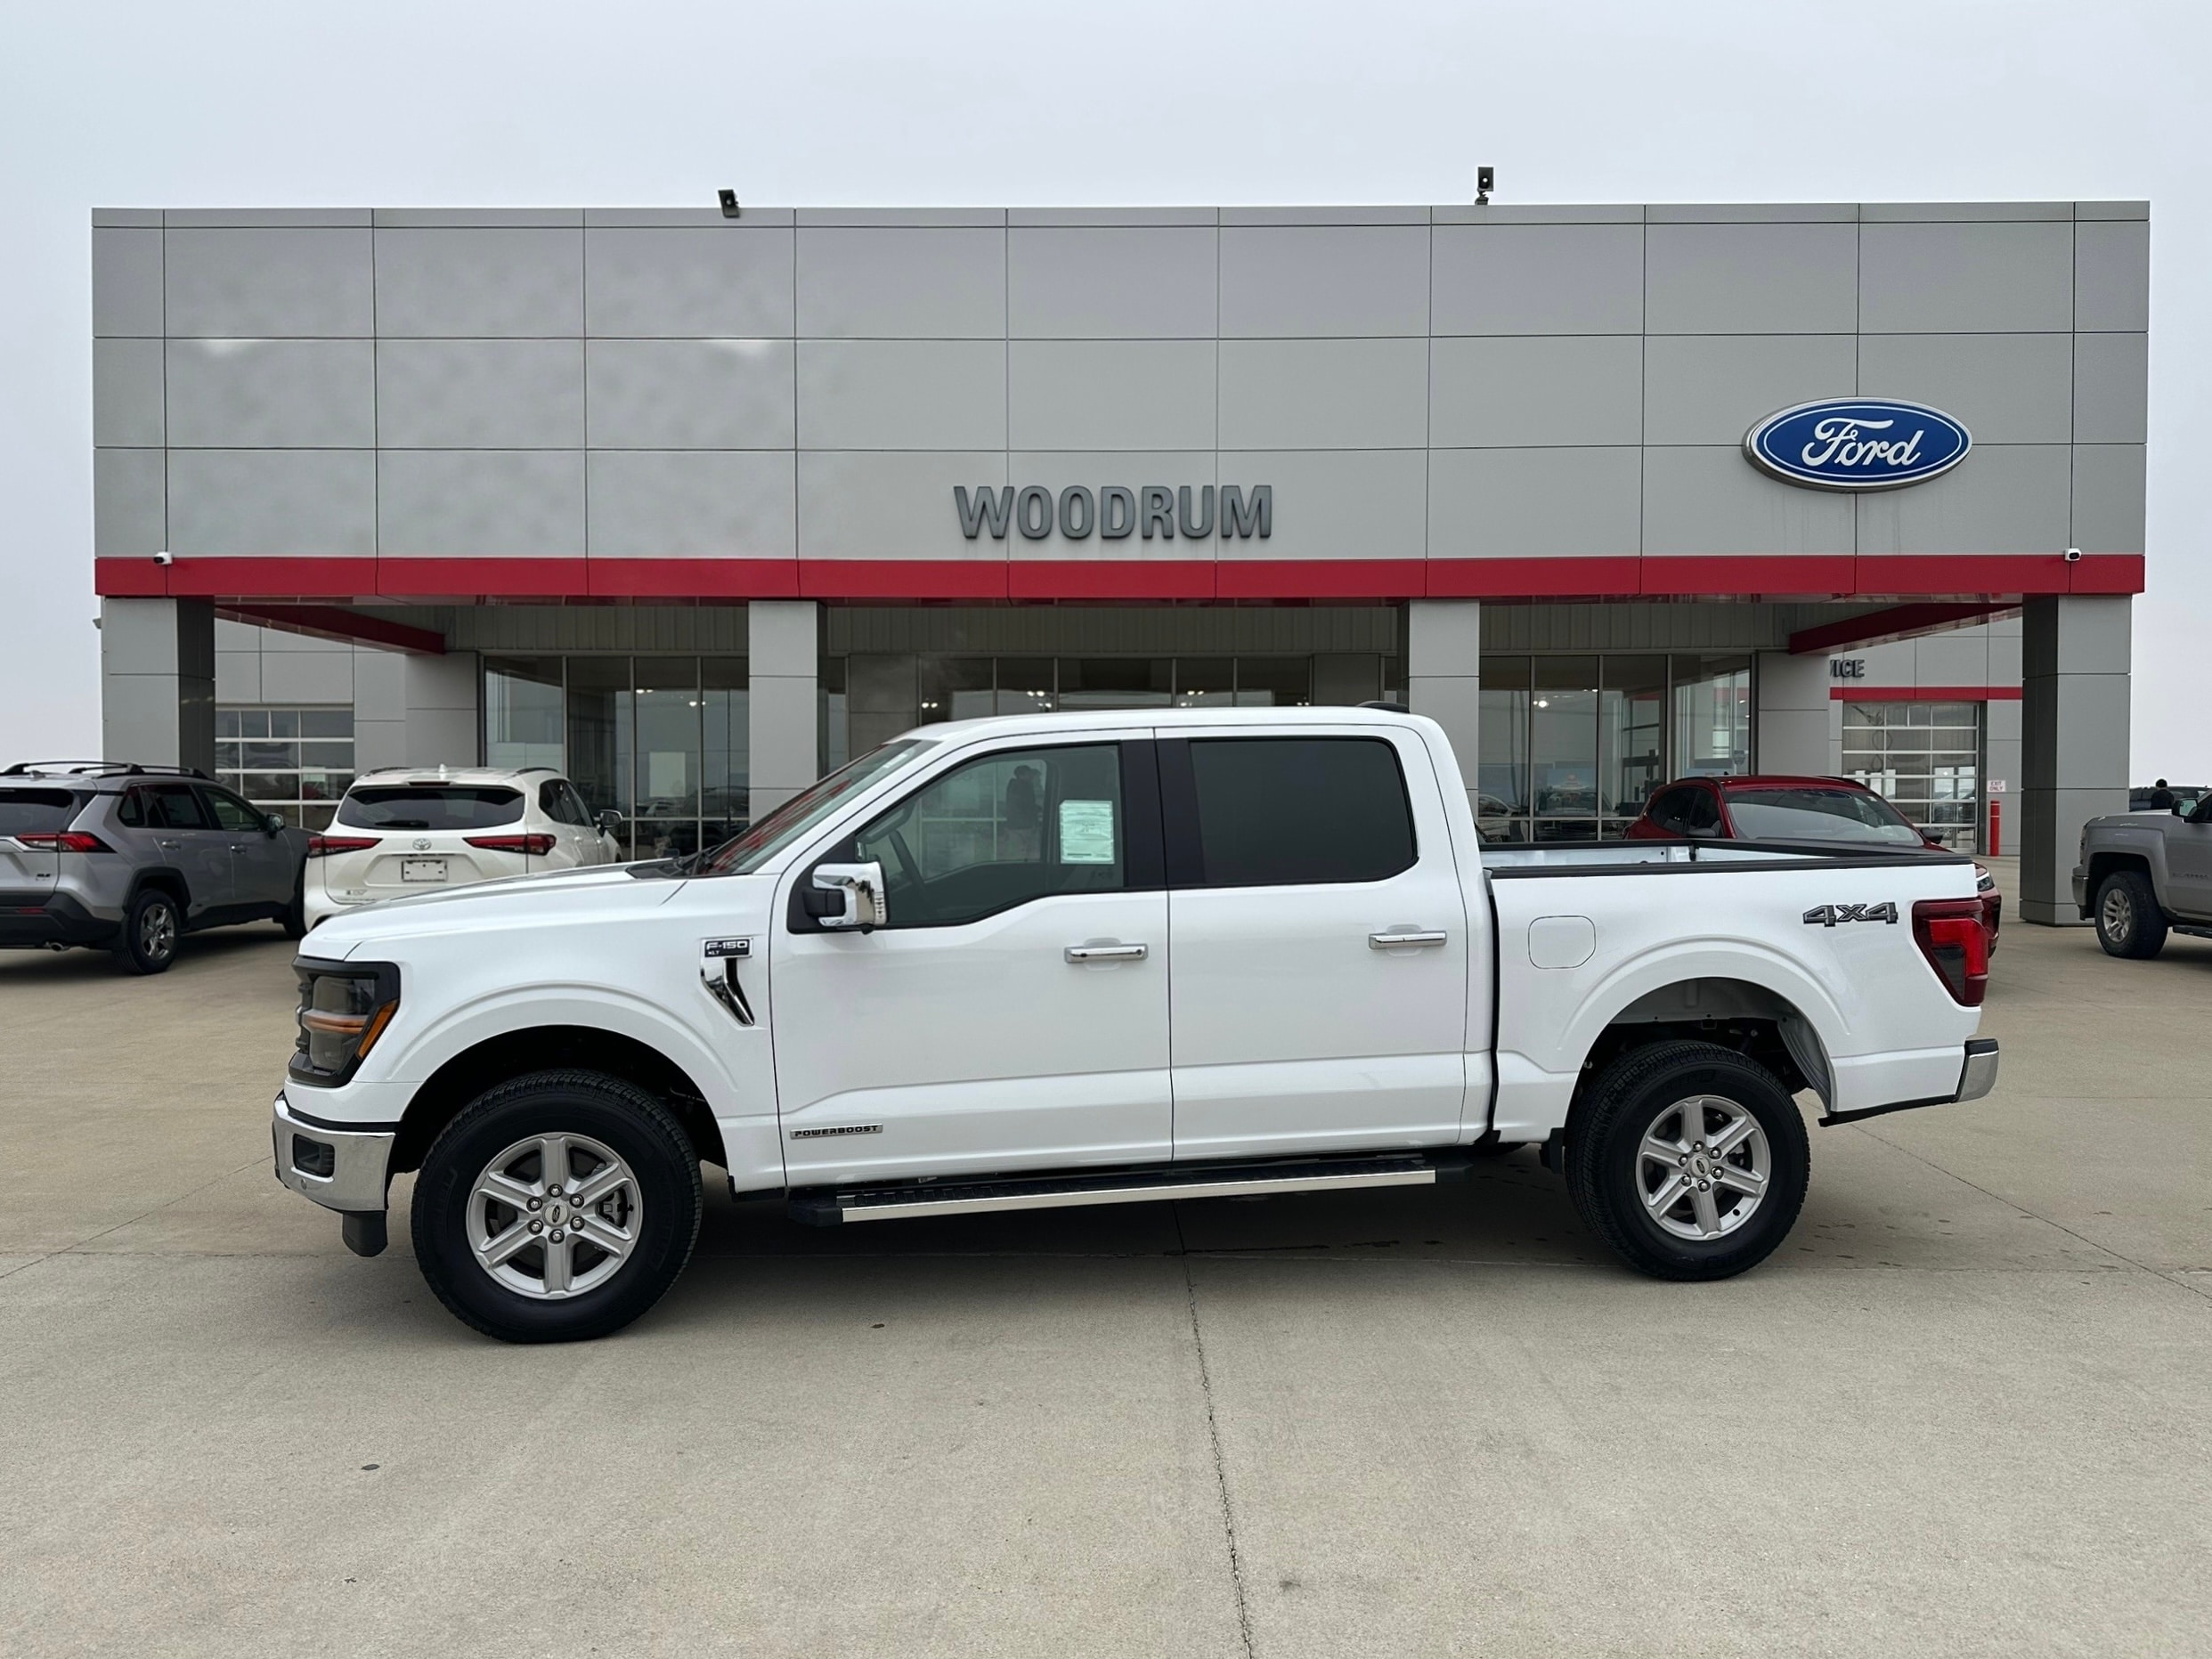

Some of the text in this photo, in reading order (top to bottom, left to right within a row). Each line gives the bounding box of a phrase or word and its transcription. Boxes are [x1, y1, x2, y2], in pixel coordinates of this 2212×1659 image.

[1801, 417, 1925, 467] Ford
[953, 484, 1273, 540] WOODRUM
[706, 940, 748, 950] F-150
[794, 1125, 879, 1137] POWERBOOST
